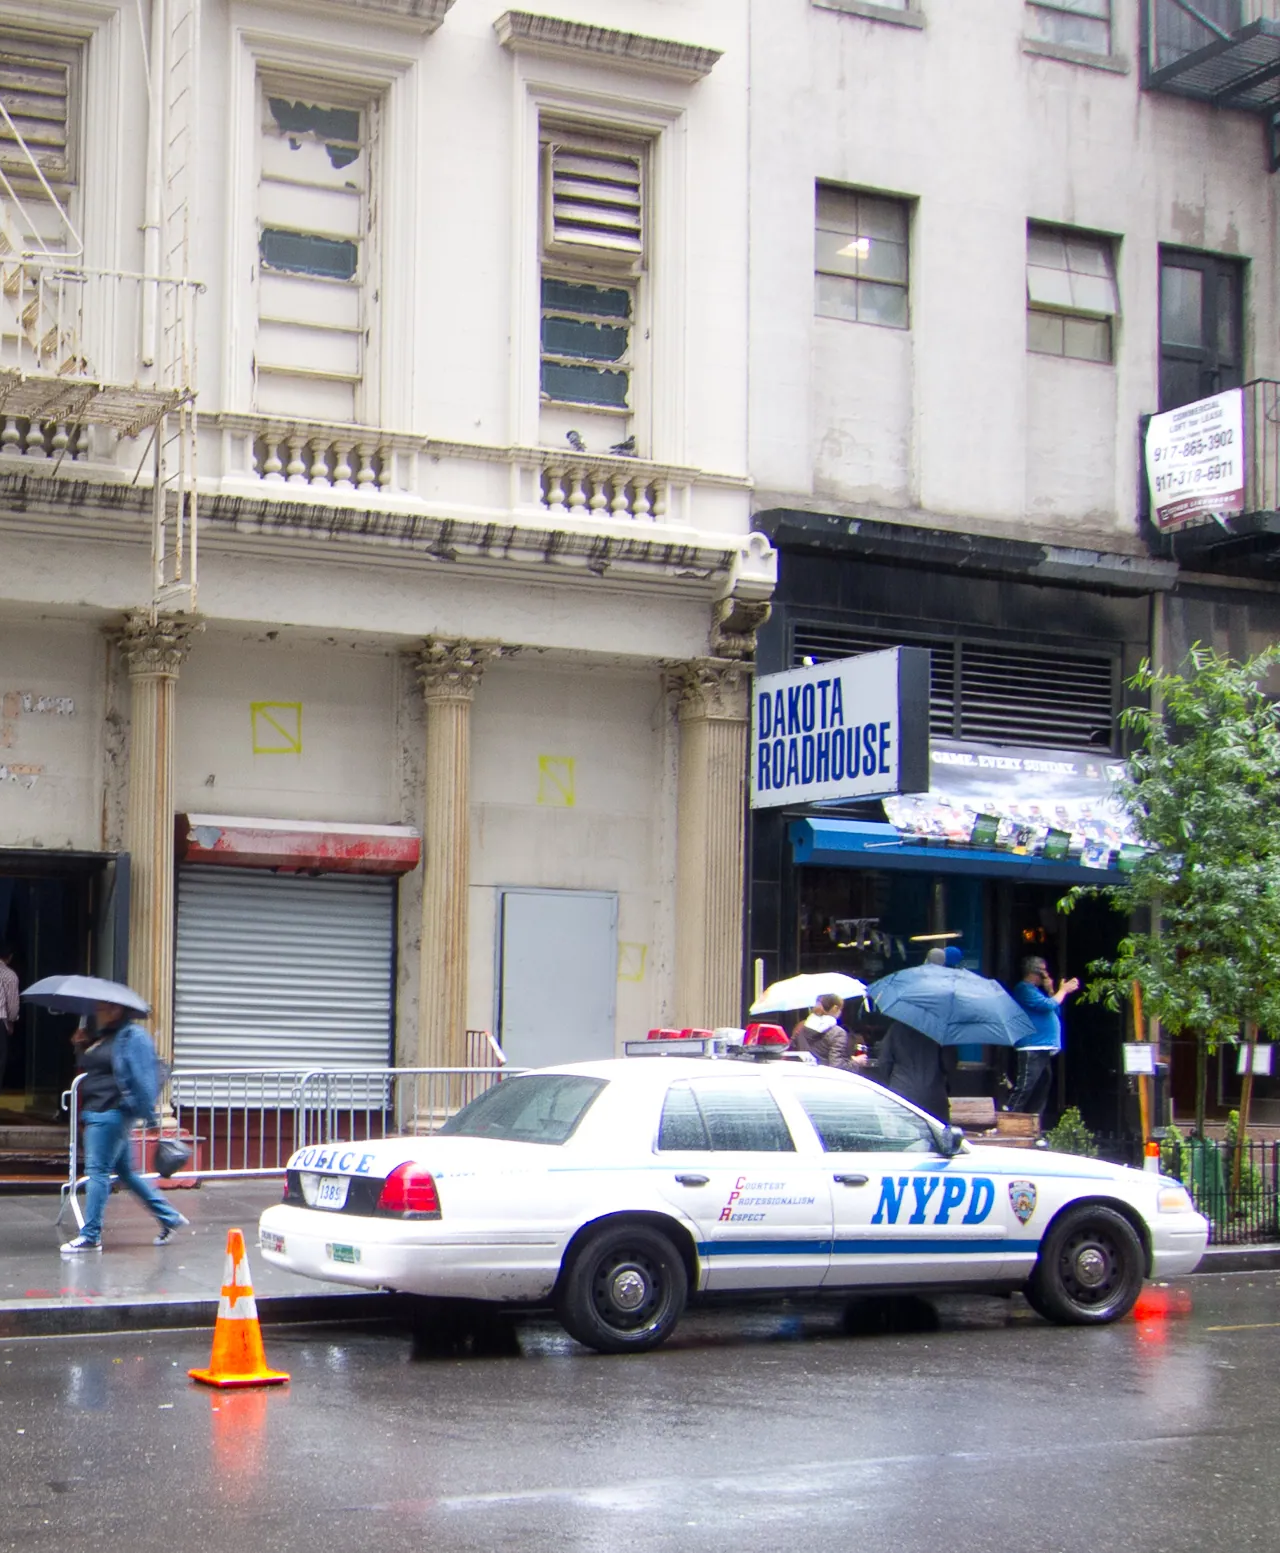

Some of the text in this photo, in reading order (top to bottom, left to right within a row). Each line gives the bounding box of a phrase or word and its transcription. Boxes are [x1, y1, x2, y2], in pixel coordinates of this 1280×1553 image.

[1154, 429, 1233, 461] 917-865-3902
[1156, 460, 1232, 492] 917-318-6971
[758, 677, 844, 740] DAKOTA
[758, 721, 891, 792] ROADHOUSE
[978, 755, 1022, 770] EVERY
[293, 1148, 376, 1174] POLICE
[871, 1176, 995, 1224] NYPD
